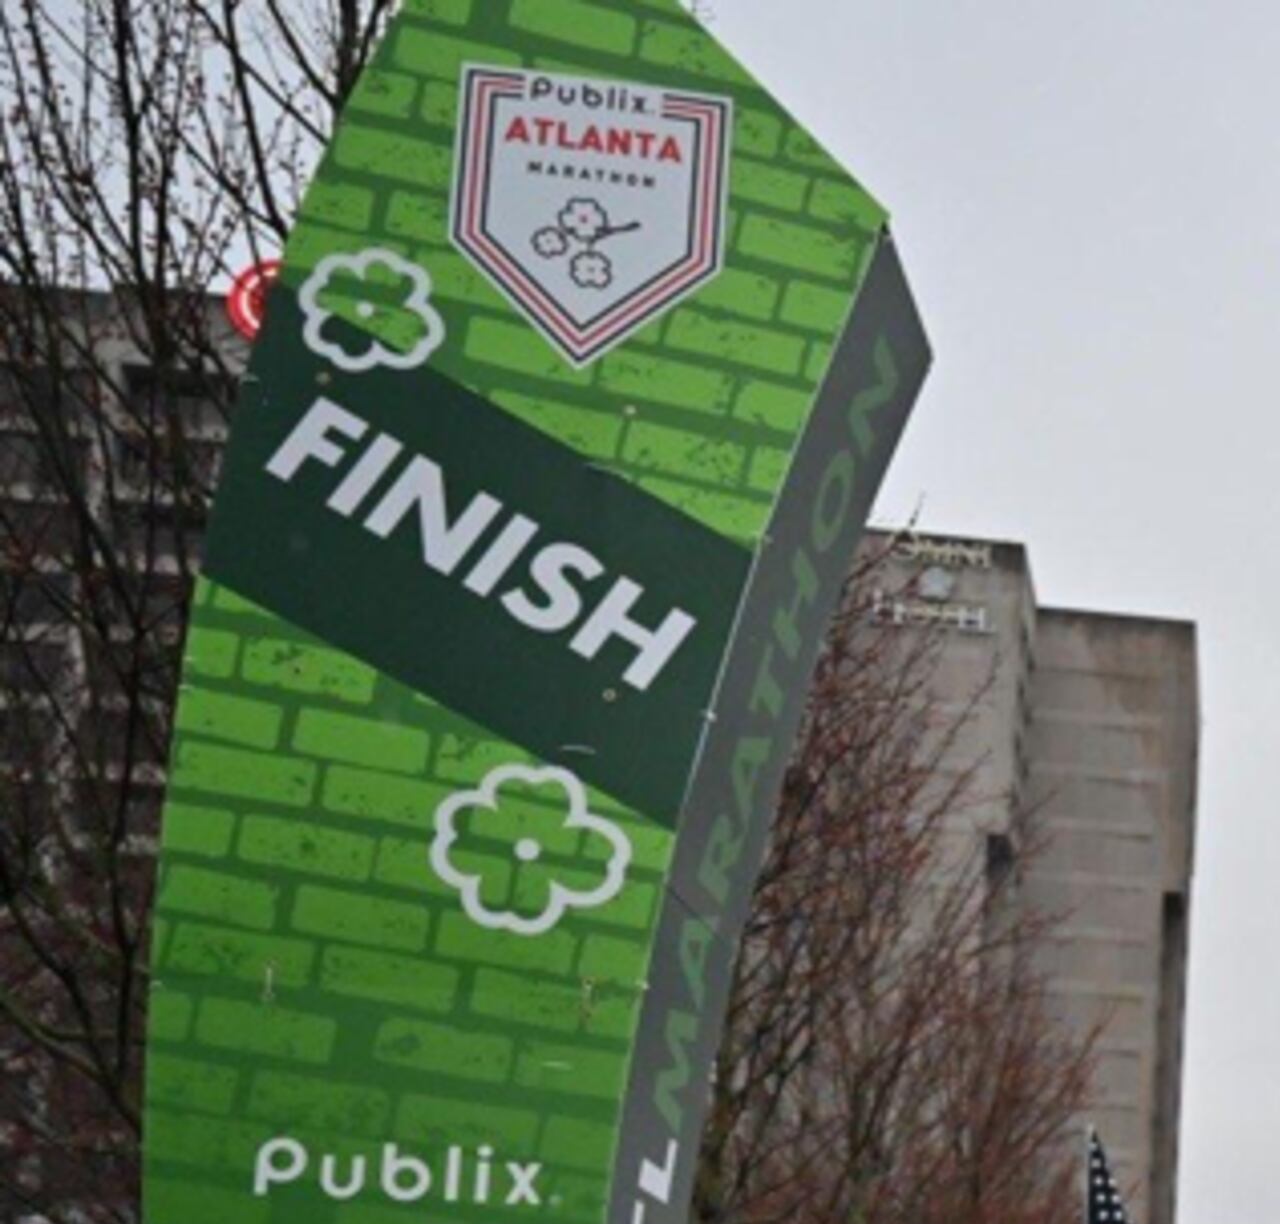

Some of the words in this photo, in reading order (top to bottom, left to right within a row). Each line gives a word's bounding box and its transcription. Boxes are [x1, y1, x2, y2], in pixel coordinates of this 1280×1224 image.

[529, 76, 650, 115] Publix
[504, 116, 682, 164] ATLANTA
[527, 161, 656, 188] MARATHON
[263, 396, 697, 692] FINISH
[253, 1136, 543, 1206] Publix
